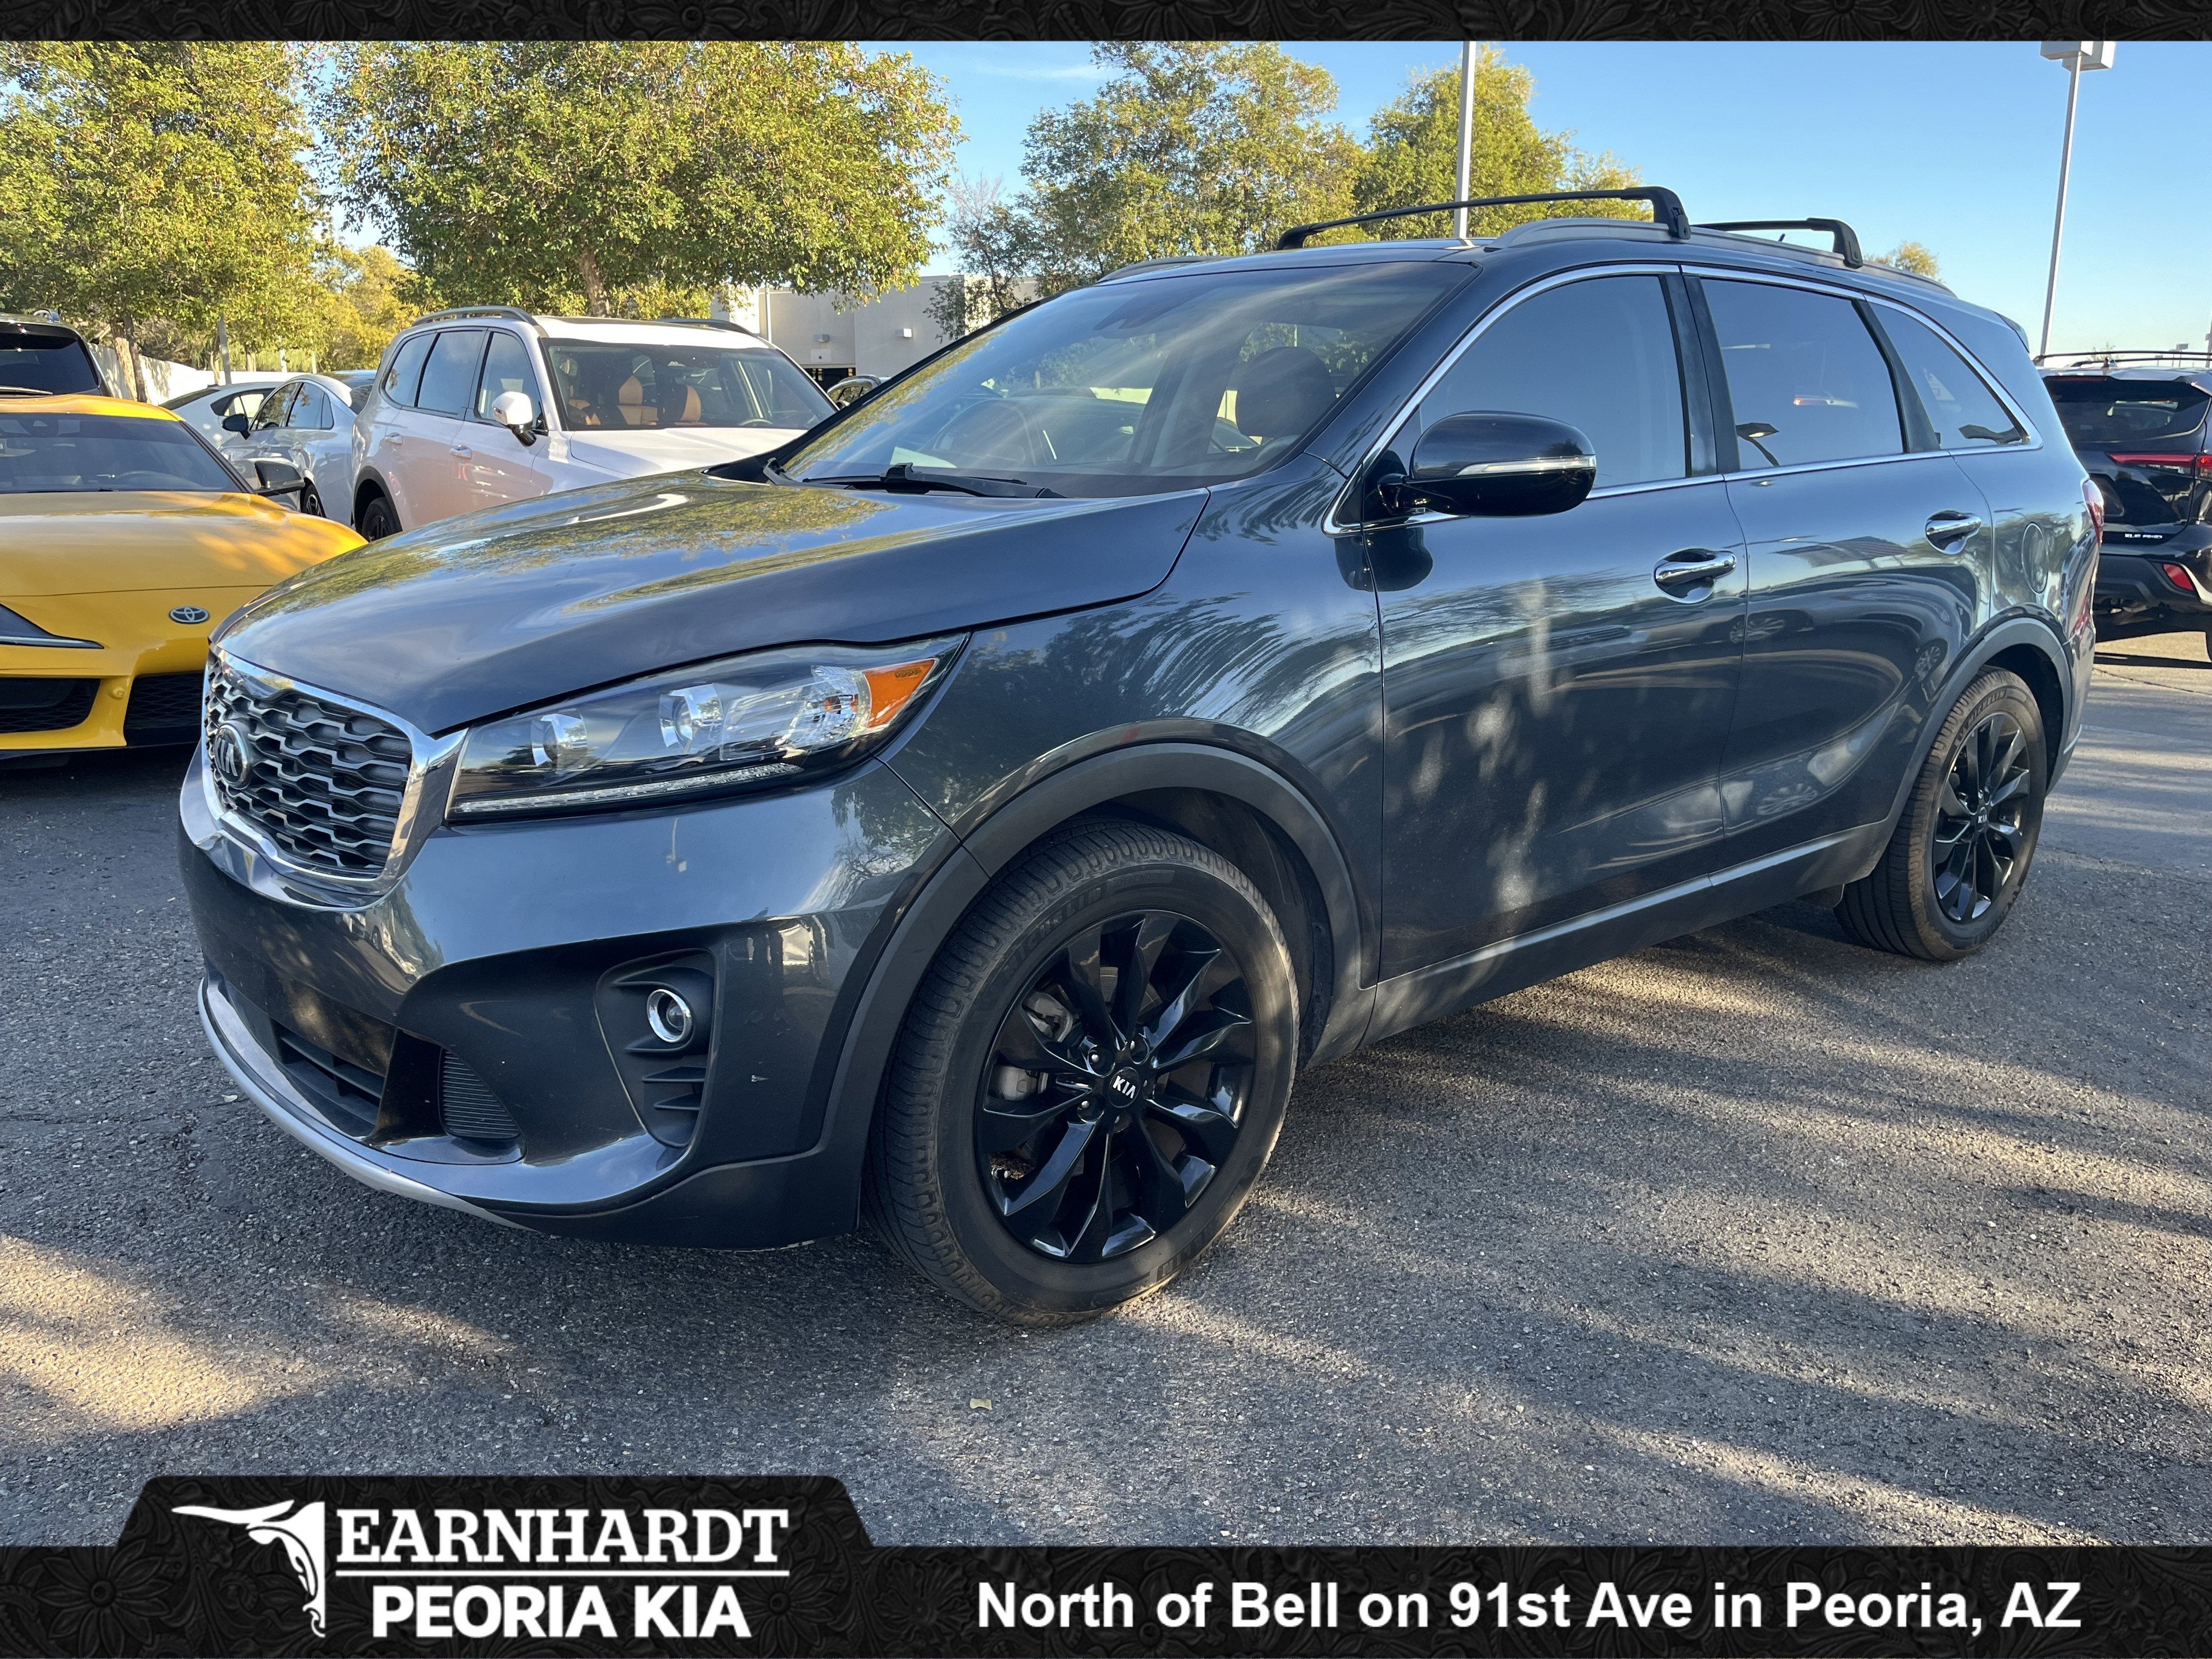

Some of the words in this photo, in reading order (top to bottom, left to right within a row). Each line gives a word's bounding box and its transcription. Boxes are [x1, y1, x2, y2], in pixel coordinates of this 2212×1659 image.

[1978, 814, 1988, 823] KIA
[1001, 886, 1103, 979] MICHELIN
[1113, 1075, 1136, 1099] KIA
